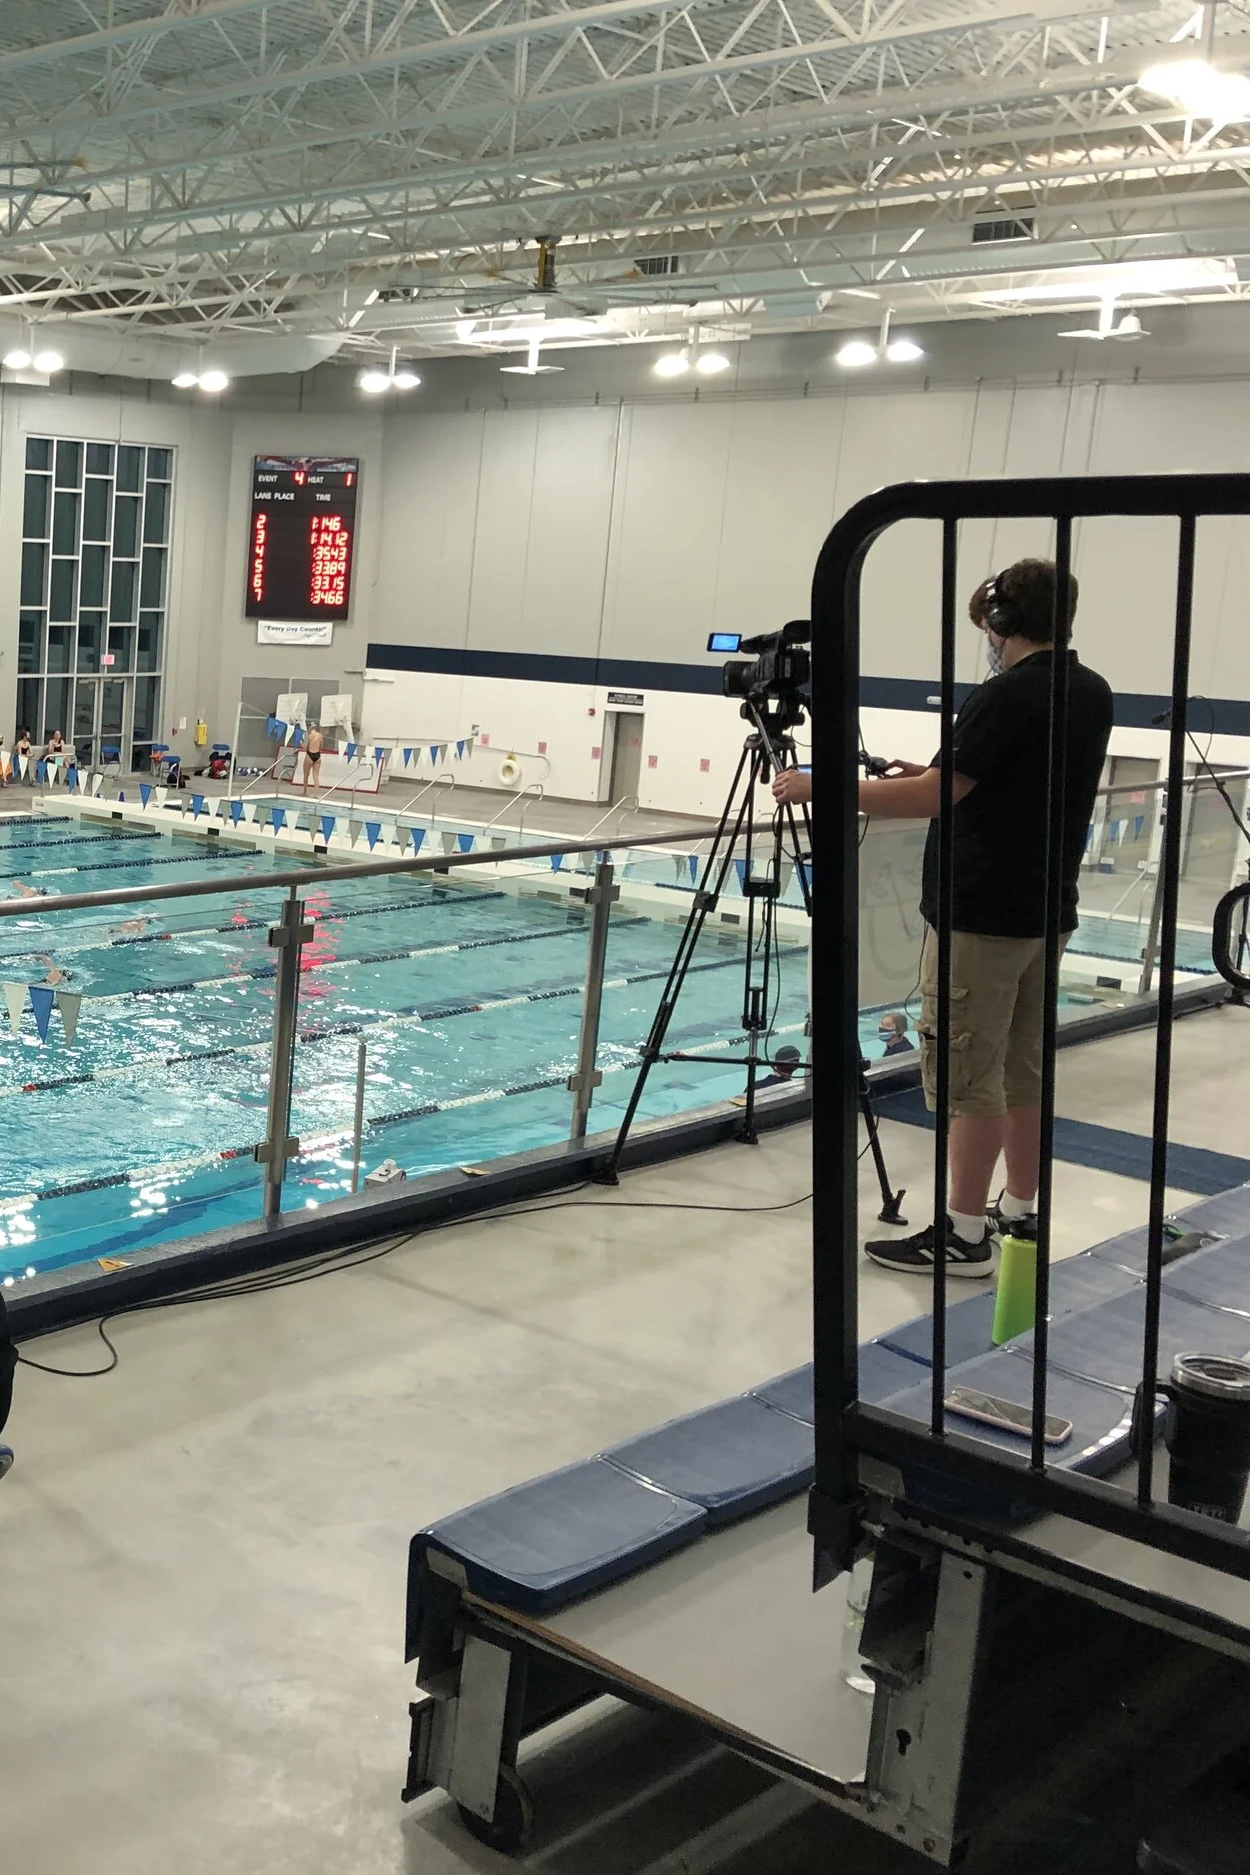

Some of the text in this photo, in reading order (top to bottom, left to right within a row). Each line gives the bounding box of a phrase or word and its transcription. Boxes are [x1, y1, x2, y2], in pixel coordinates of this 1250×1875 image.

[258, 471, 352, 487] EVENT 4 HEAT 1
[254, 491, 332, 501] LANE PLACE TIME
[256, 513, 267, 529] 2
[255, 529, 266, 544] 3
[255, 544, 265, 558] 4
[254, 558, 263, 573] 5
[253, 573, 263, 588] 6
[254, 588, 263, 602] 7
